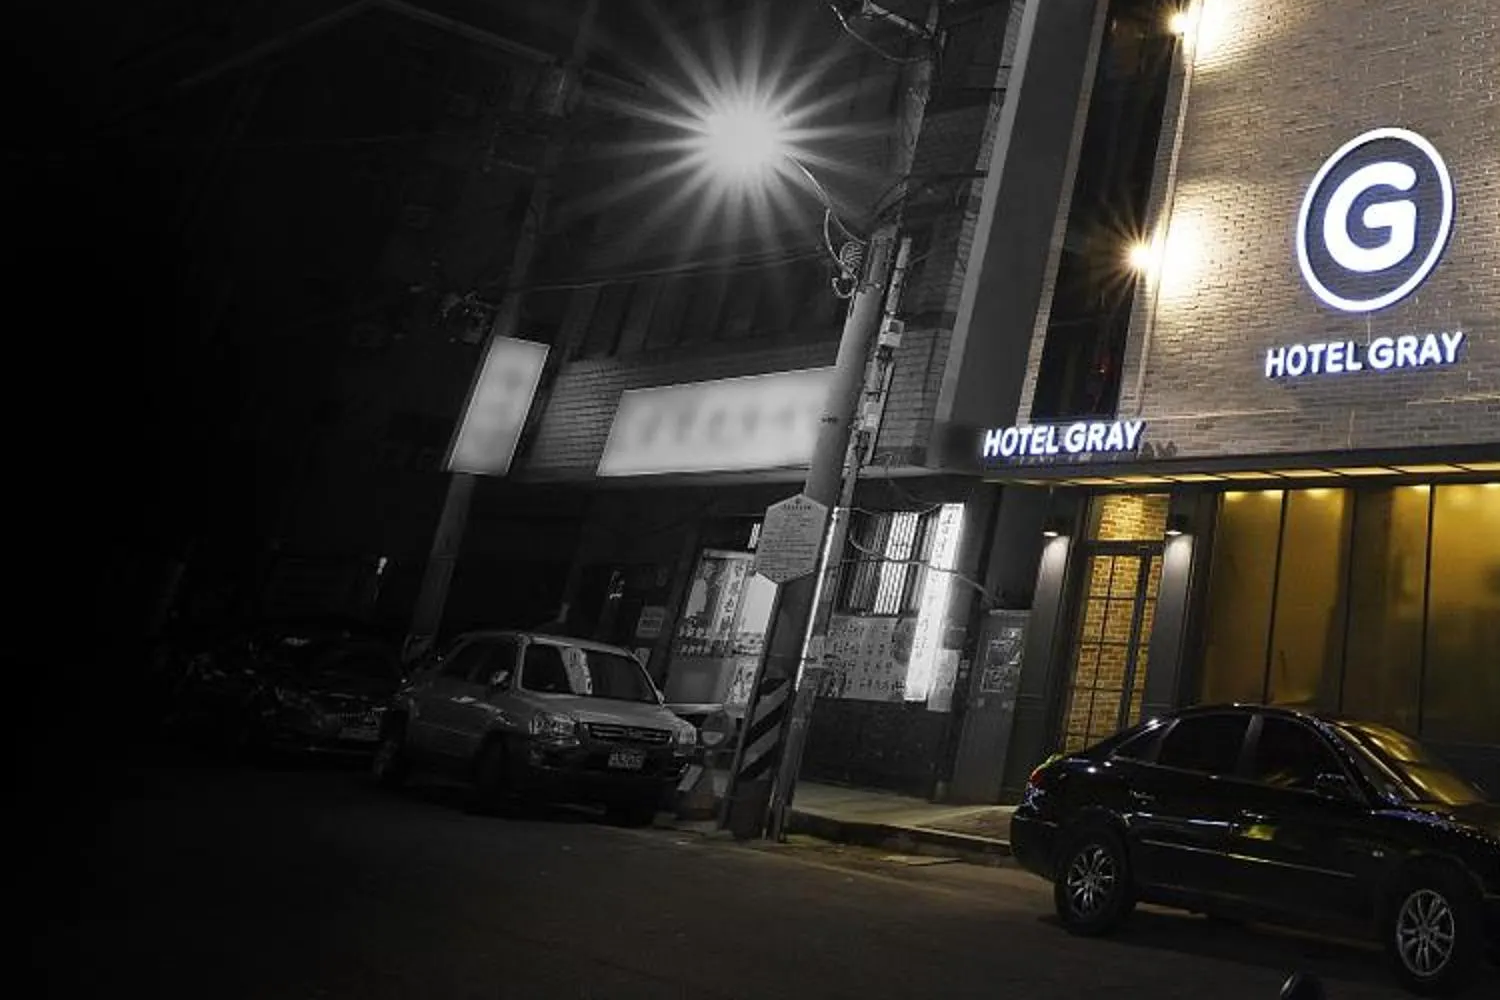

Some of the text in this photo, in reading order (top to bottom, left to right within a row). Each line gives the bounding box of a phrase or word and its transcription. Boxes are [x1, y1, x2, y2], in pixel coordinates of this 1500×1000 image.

[1322, 160, 1419, 273] G
[1264, 330, 1467, 378] HOTEL GRAY
[982, 419, 1146, 459] HOTEL GRAY
